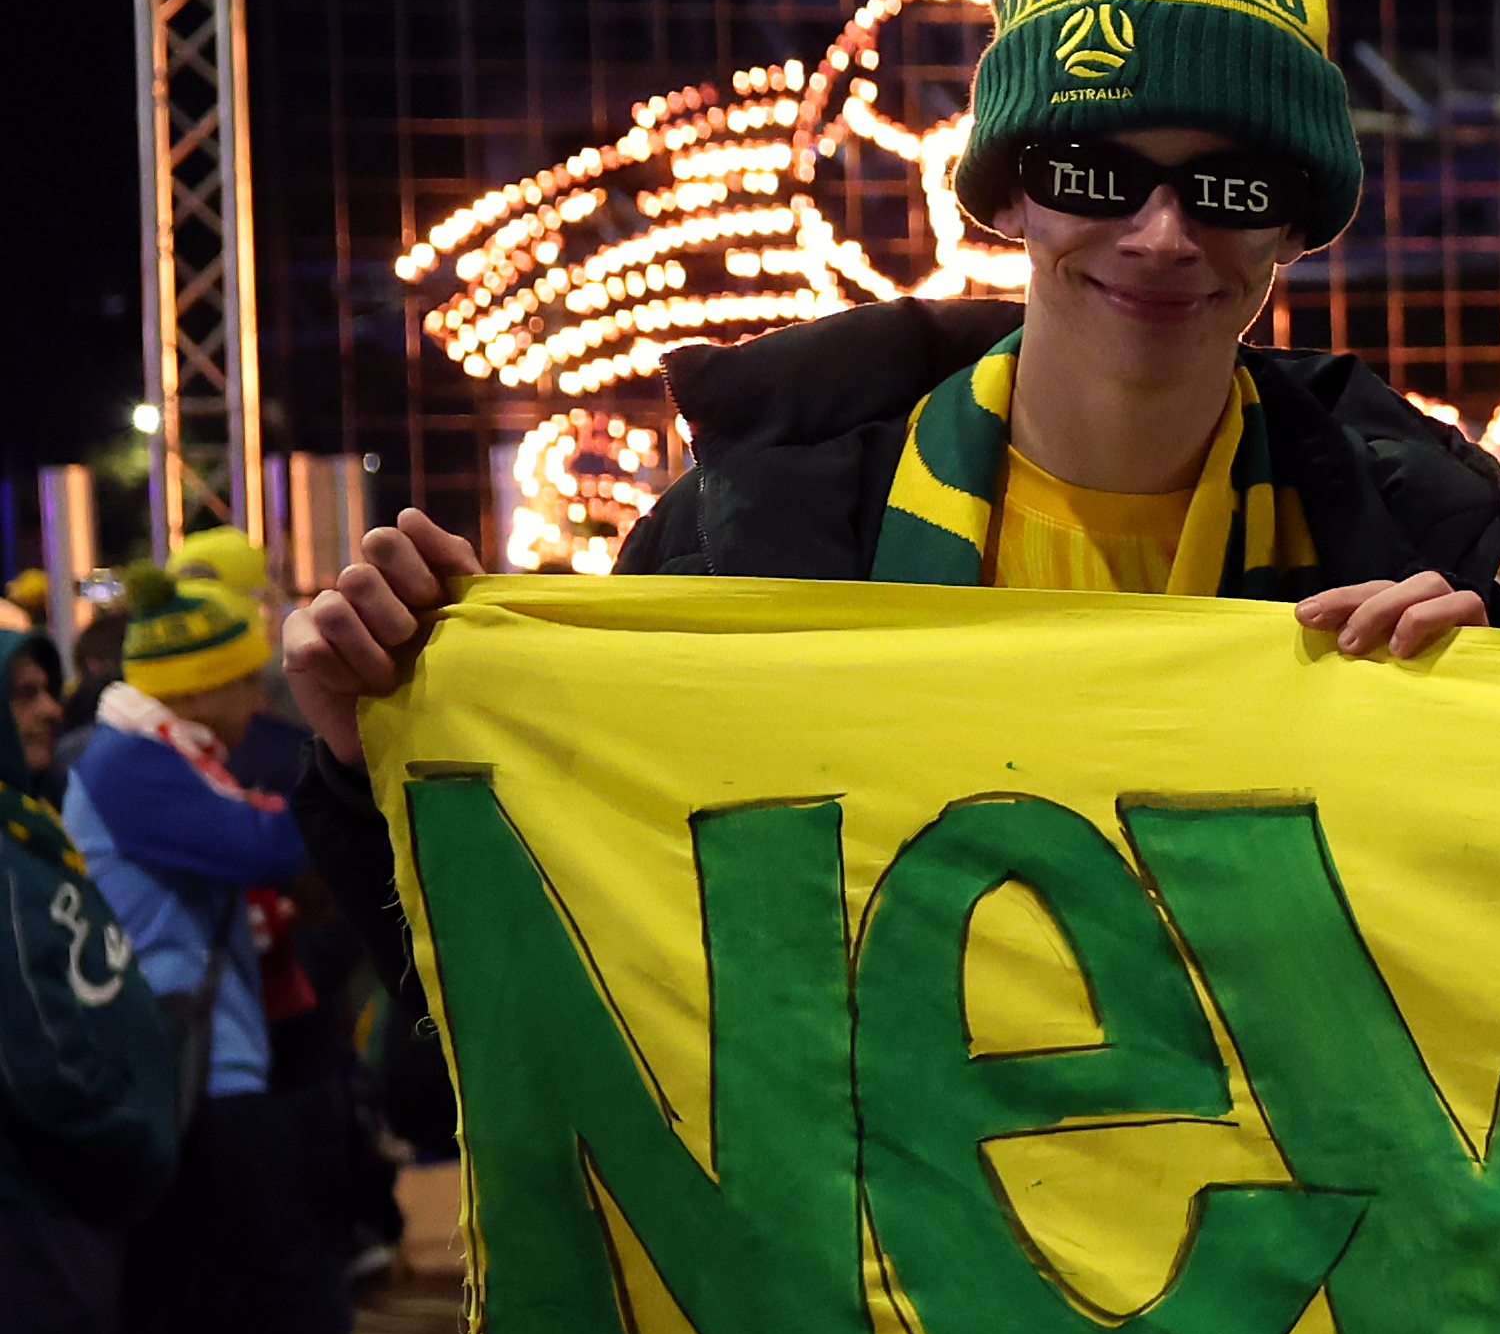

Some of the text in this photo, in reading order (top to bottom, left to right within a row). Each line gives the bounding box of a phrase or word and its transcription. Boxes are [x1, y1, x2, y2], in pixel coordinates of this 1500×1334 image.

[1050, 86, 1134, 105] AUSTRALIA
[1048, 160, 1270, 213] TILL IES
